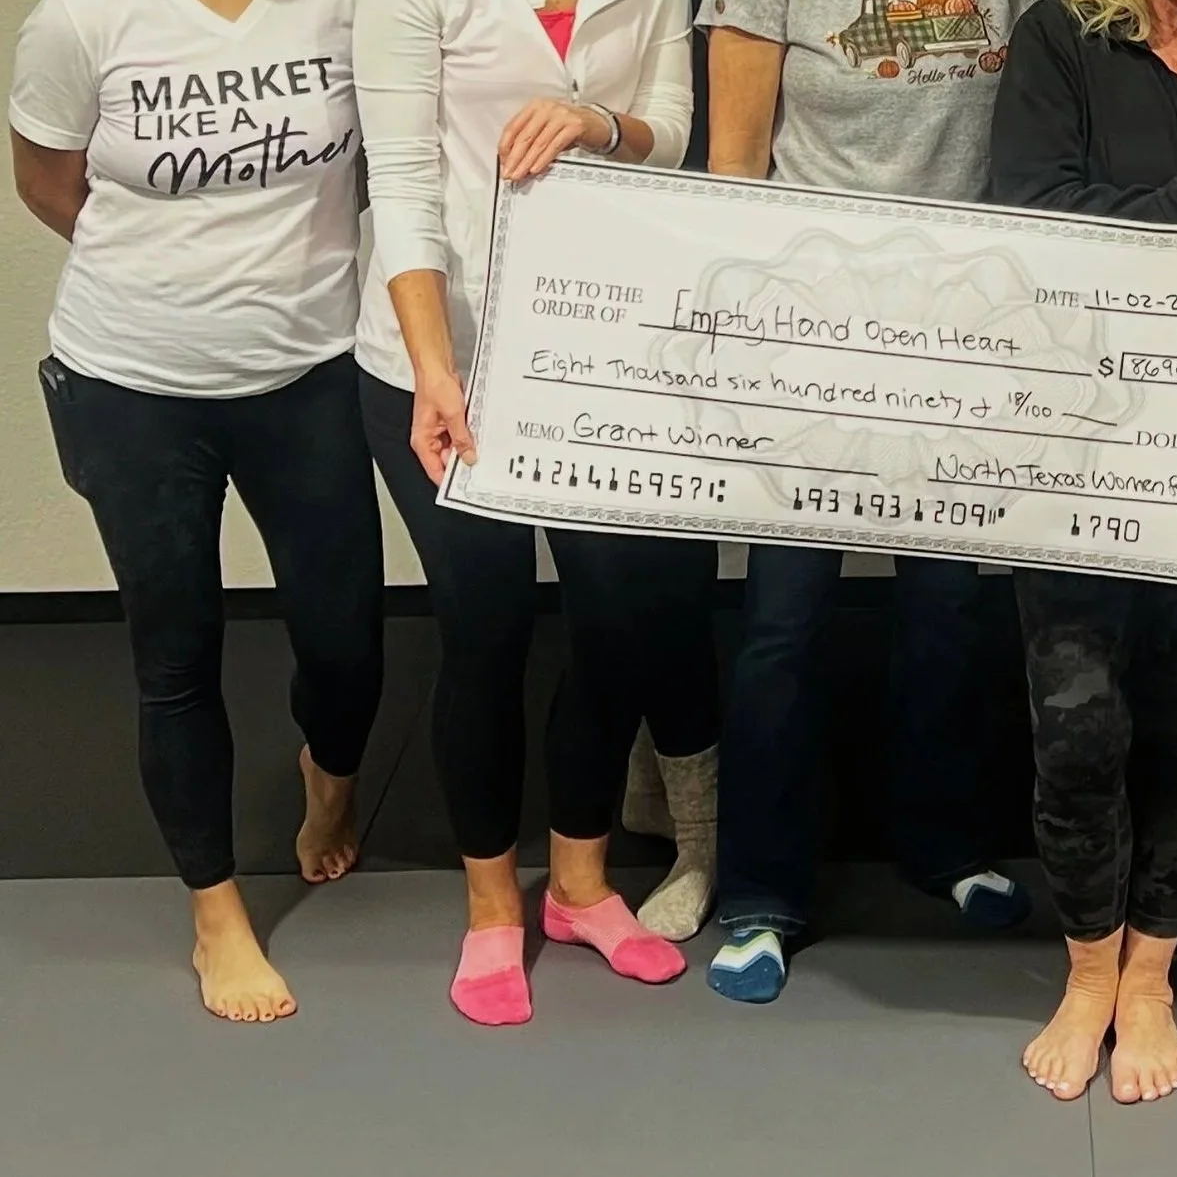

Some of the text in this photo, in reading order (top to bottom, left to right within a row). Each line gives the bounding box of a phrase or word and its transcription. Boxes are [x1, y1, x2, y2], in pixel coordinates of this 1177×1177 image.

[131, 57, 333, 113] MARKET
[907, 63, 977, 86] Hello Fall
[134, 107, 258, 141] LIKE A
[535, 276, 644, 304] PAY TO THE
[1035, 287, 1080, 308] DATE
[532, 298, 627, 323] ORDER OF
[673, 289, 768, 354] Empty
[775, 305, 852, 341] Hand
[937, 326, 1022, 357] Heart
[531, 350, 595, 381] Eight
[607, 359, 718, 388] Thousand
[728, 372, 761, 391] six
[771, 374, 876, 403] hundred
[885, 387, 962, 419] ninety
[516, 420, 564, 443] MEMO
[572, 413, 775, 451] Grant Winner
[936, 454, 1017, 486] North
[1016, 464, 1086, 489] Texas
[1092, 470, 1164, 496] Women
